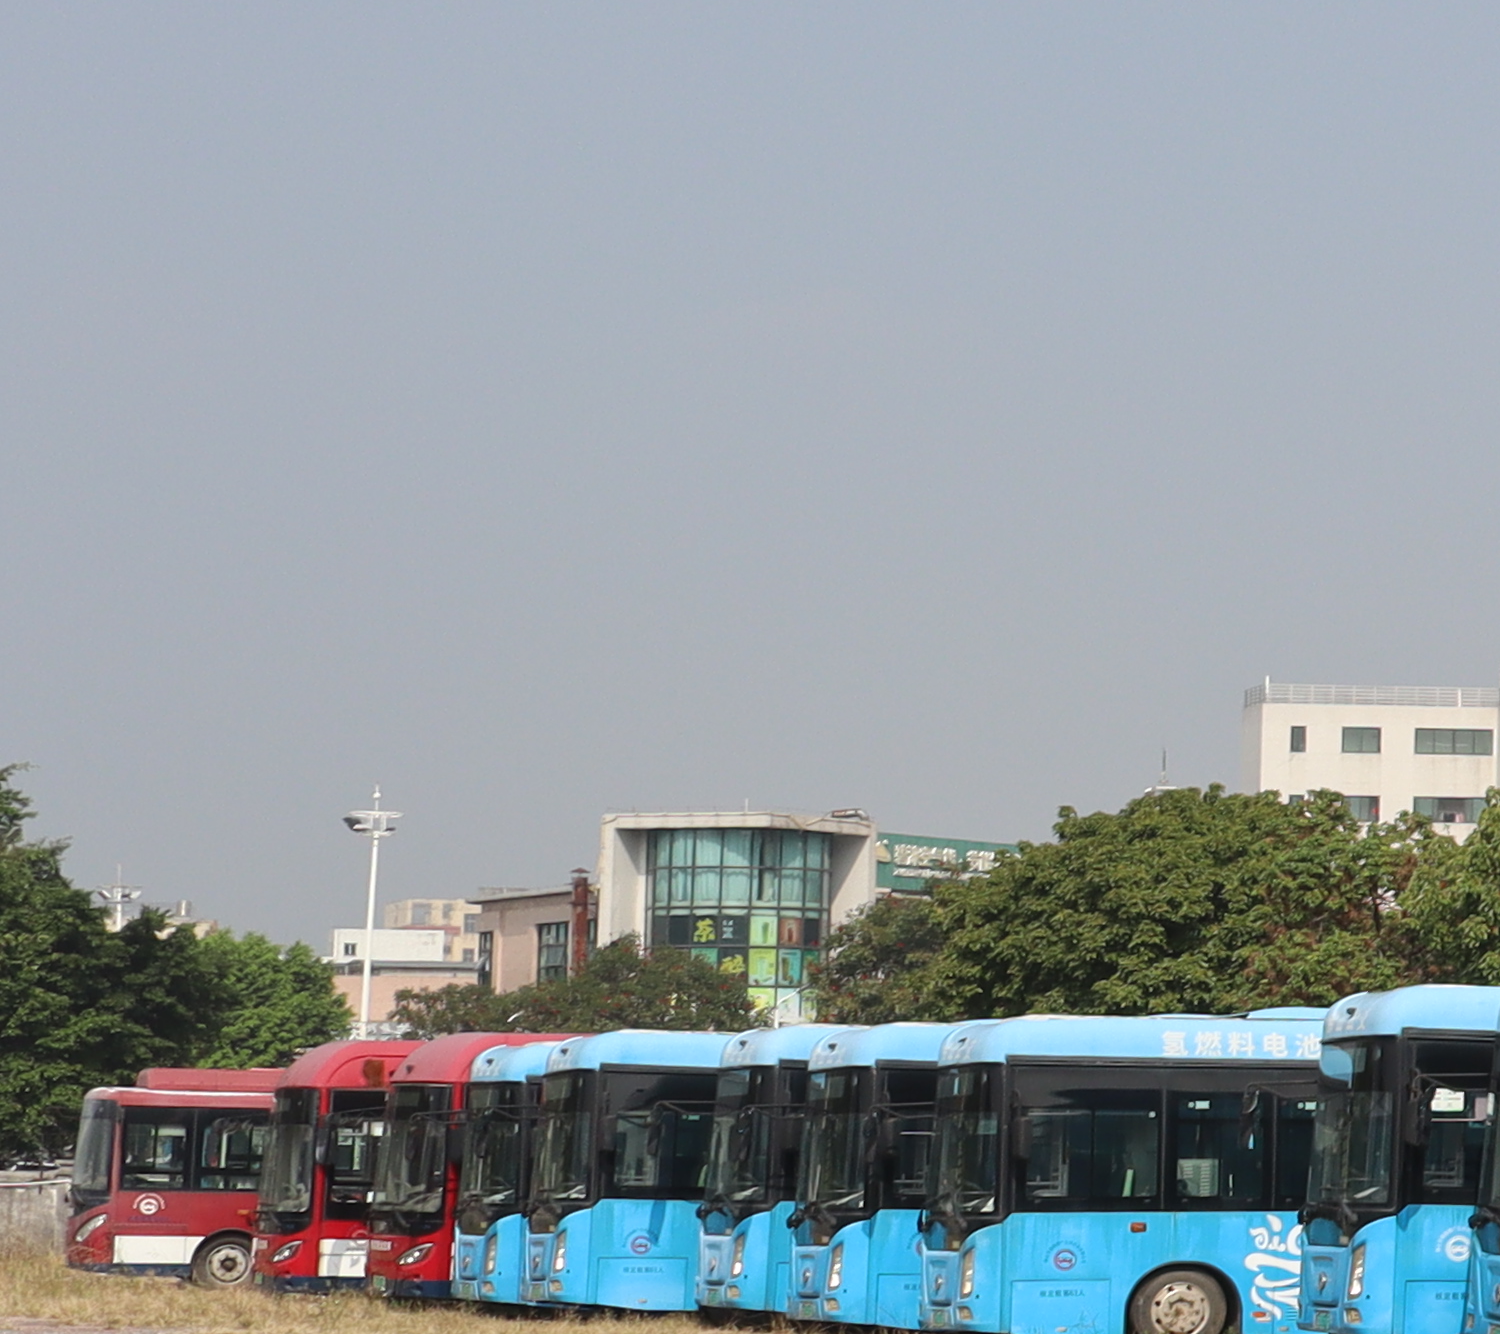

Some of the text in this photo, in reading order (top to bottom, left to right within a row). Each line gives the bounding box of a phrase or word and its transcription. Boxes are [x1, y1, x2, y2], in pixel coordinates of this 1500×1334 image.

[1161, 1030, 1321, 1059] 氢燃料电池
